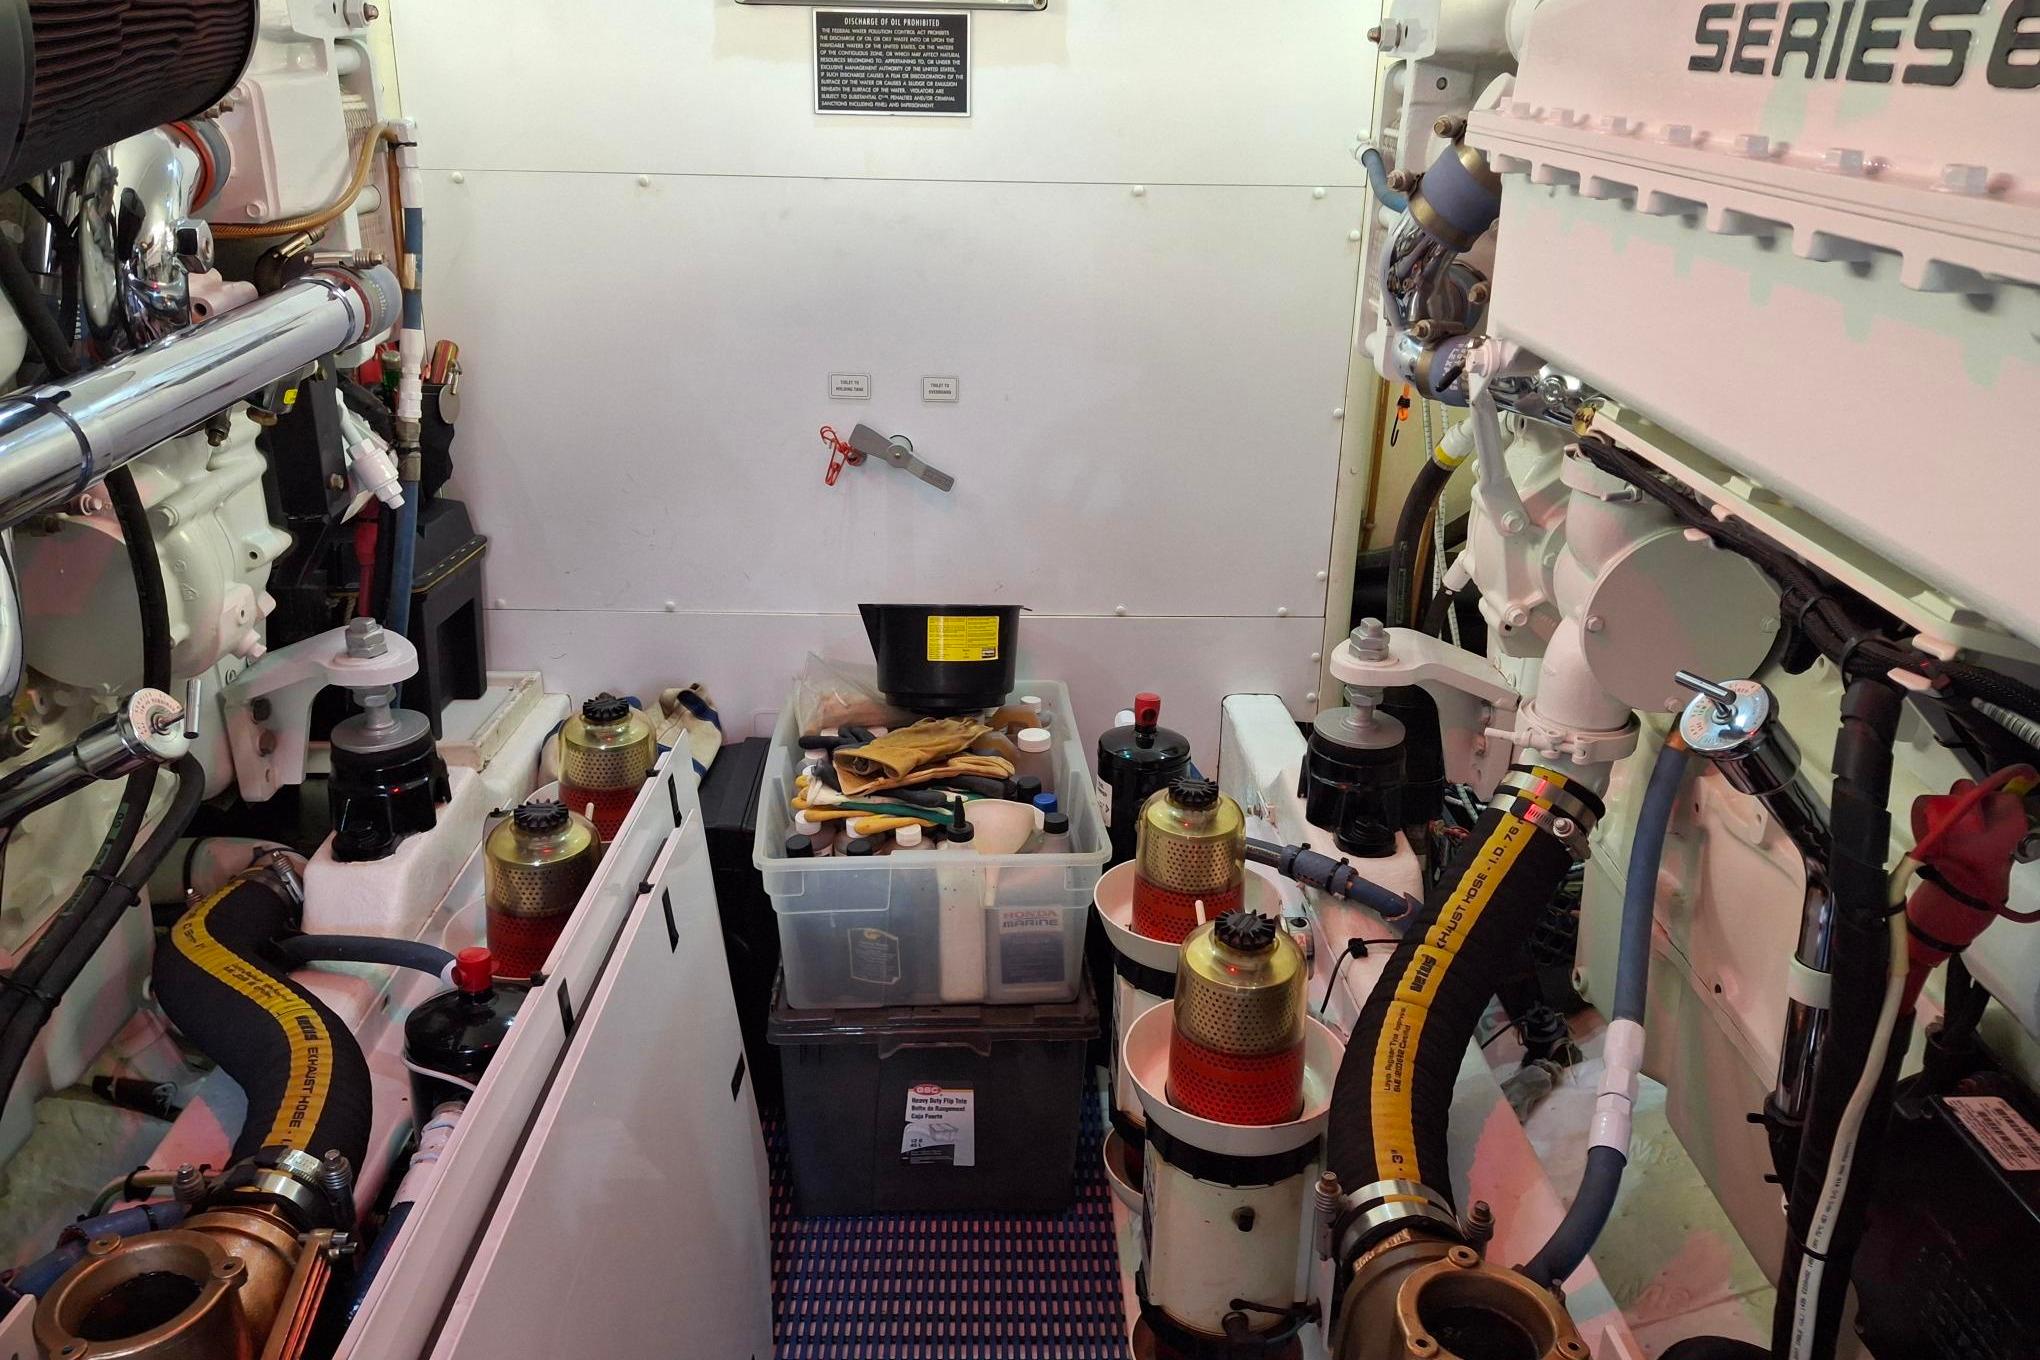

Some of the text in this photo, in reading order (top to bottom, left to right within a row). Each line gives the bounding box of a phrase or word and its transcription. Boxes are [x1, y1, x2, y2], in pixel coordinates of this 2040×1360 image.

[844, 17, 940, 27] DISCHARGE OF OIL PROHIBITED
[1688, 0, 1988, 87] SERIES
[1462, 873, 1488, 904] HOSE
[1503, 825, 1520, 843] 76
[1002, 910, 1057, 919] HONDA
[1002, 919, 1058, 928] MARINE
[302, 1046, 319, 1094] EXHAUST
[289, 1095, 311, 1129] HOSE
[930, 1097, 942, 1105] Duty
